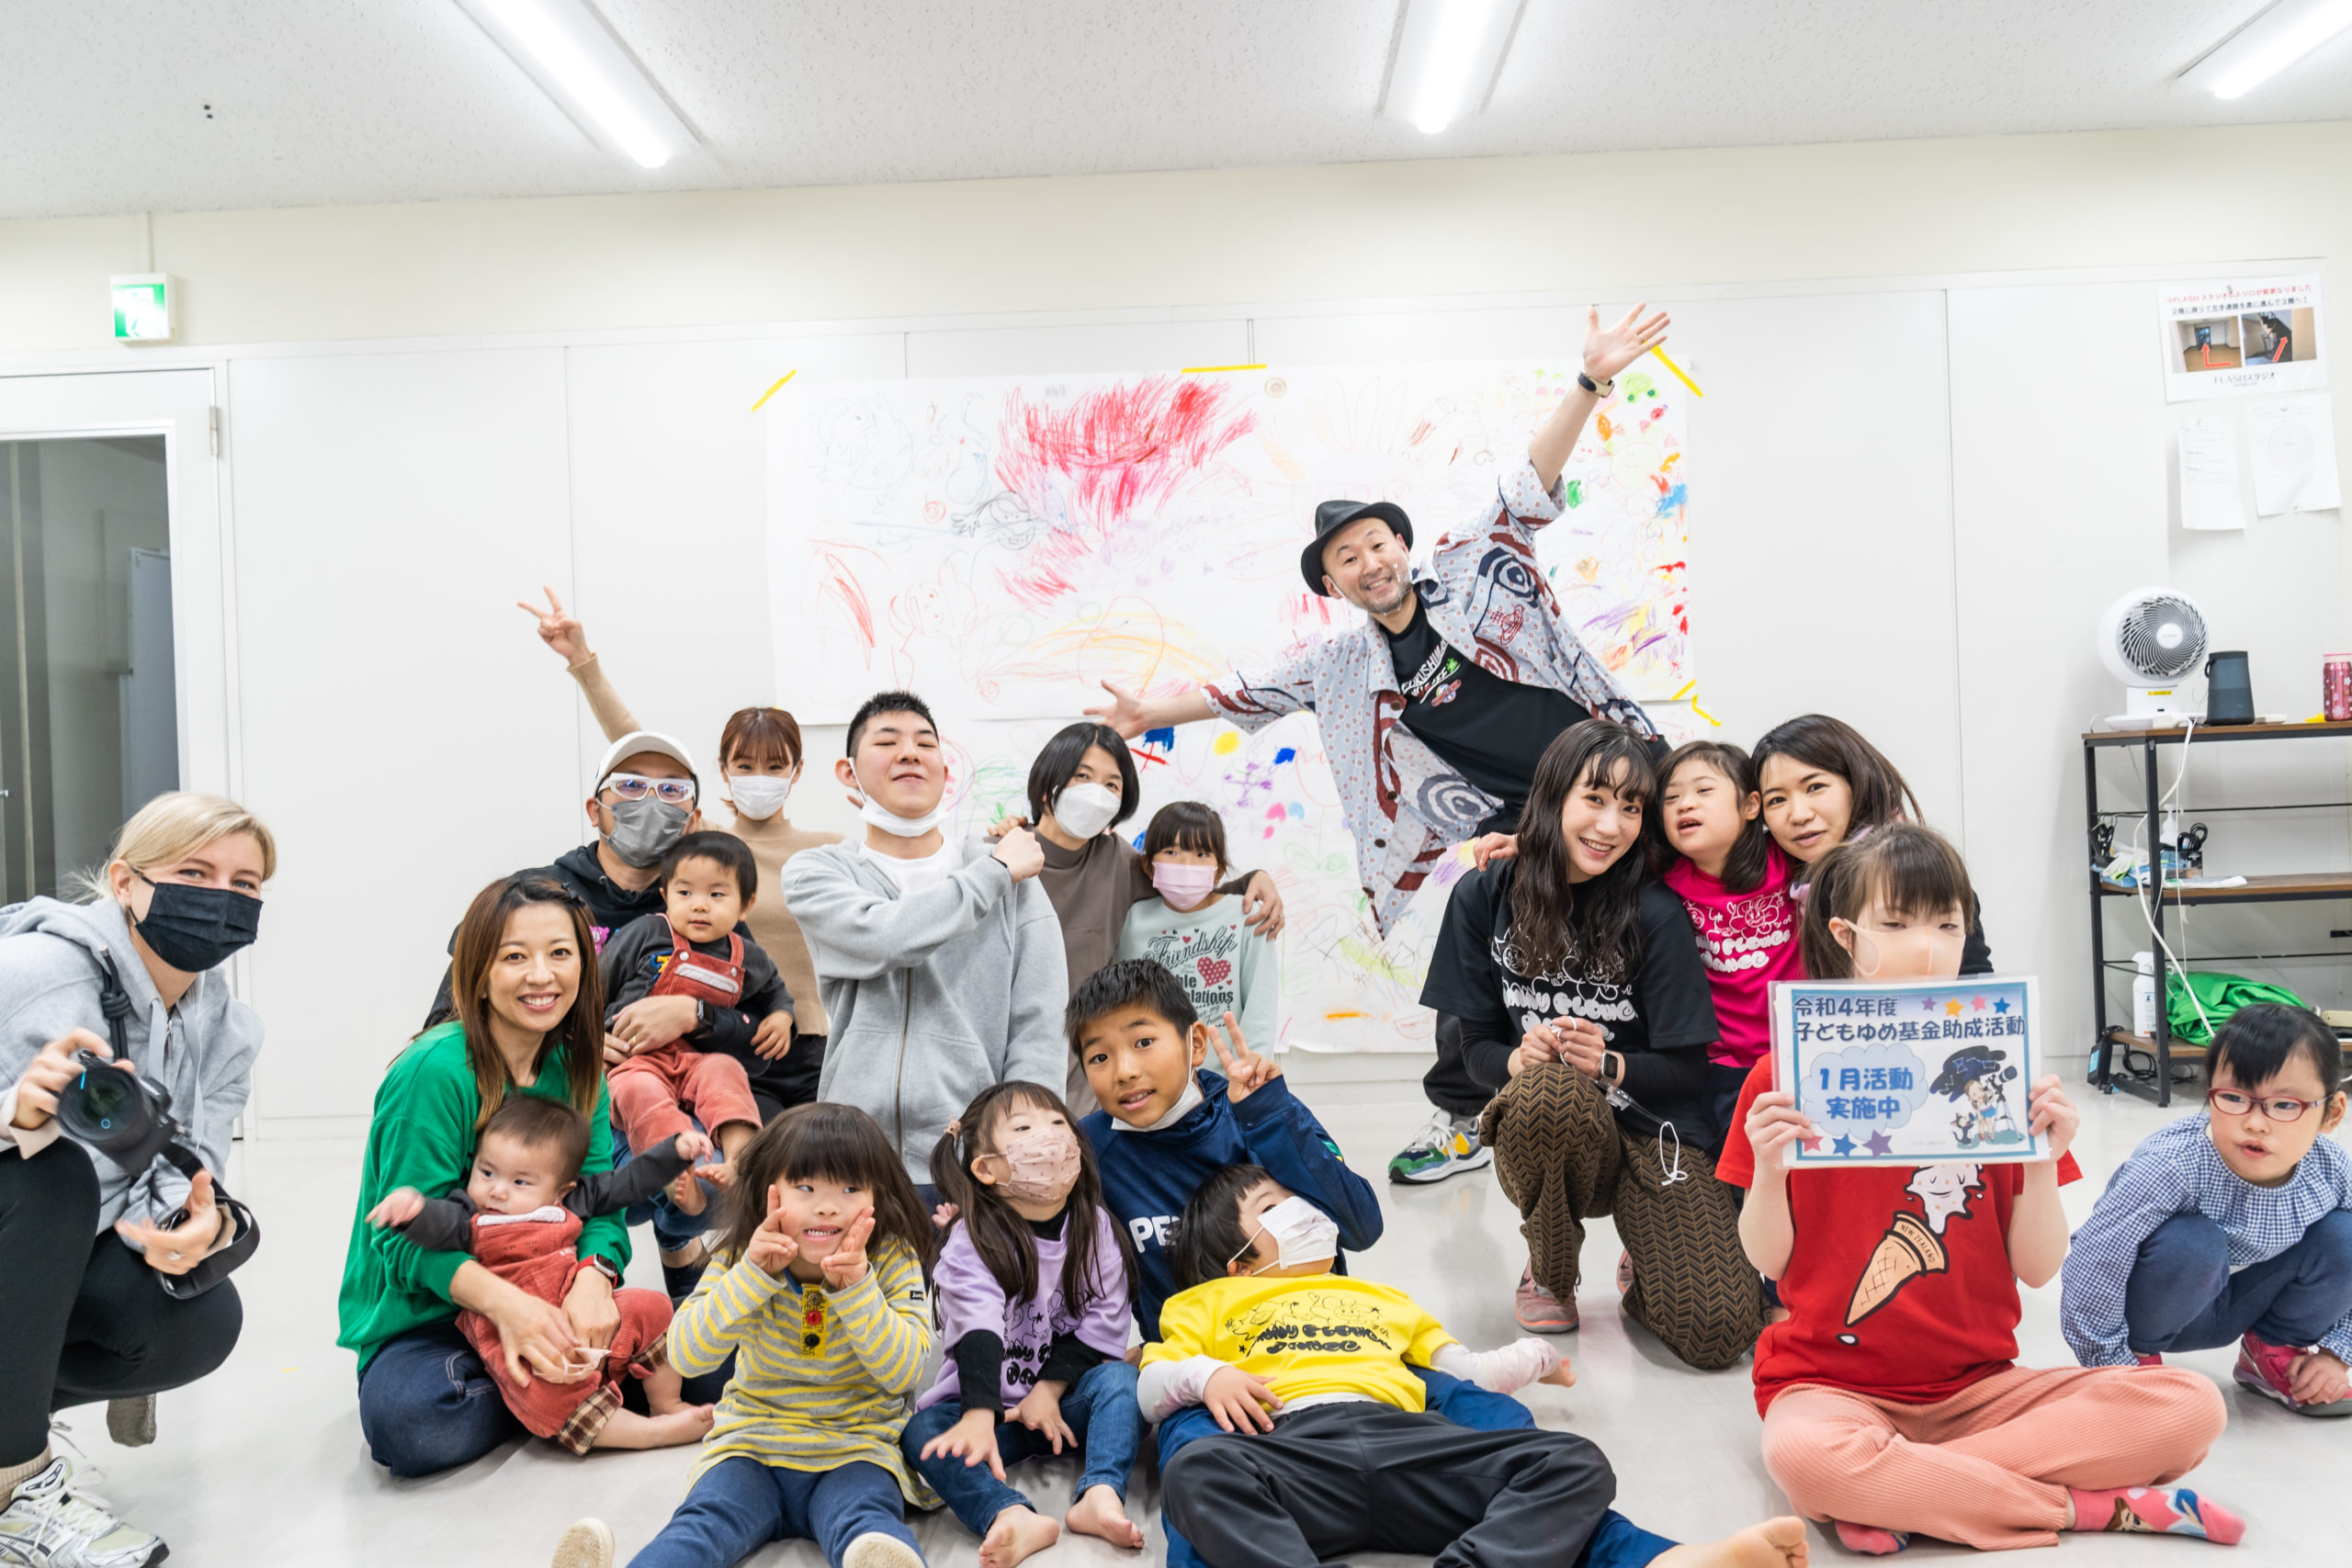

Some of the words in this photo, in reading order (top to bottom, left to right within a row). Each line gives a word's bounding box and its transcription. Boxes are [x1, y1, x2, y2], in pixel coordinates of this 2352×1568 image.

[1143, 926, 1238, 970] Friendship
[1188, 989, 1233, 1005] lations
[1794, 997, 1898, 1017] 令和4年度
[1794, 1016, 2026, 1042] 子どもゆめ基金助成活動
[1819, 1066, 1914, 1091] 1月活動
[1826, 1096, 1901, 1121] 実施中
[1128, 1215, 1181, 1253] PE
